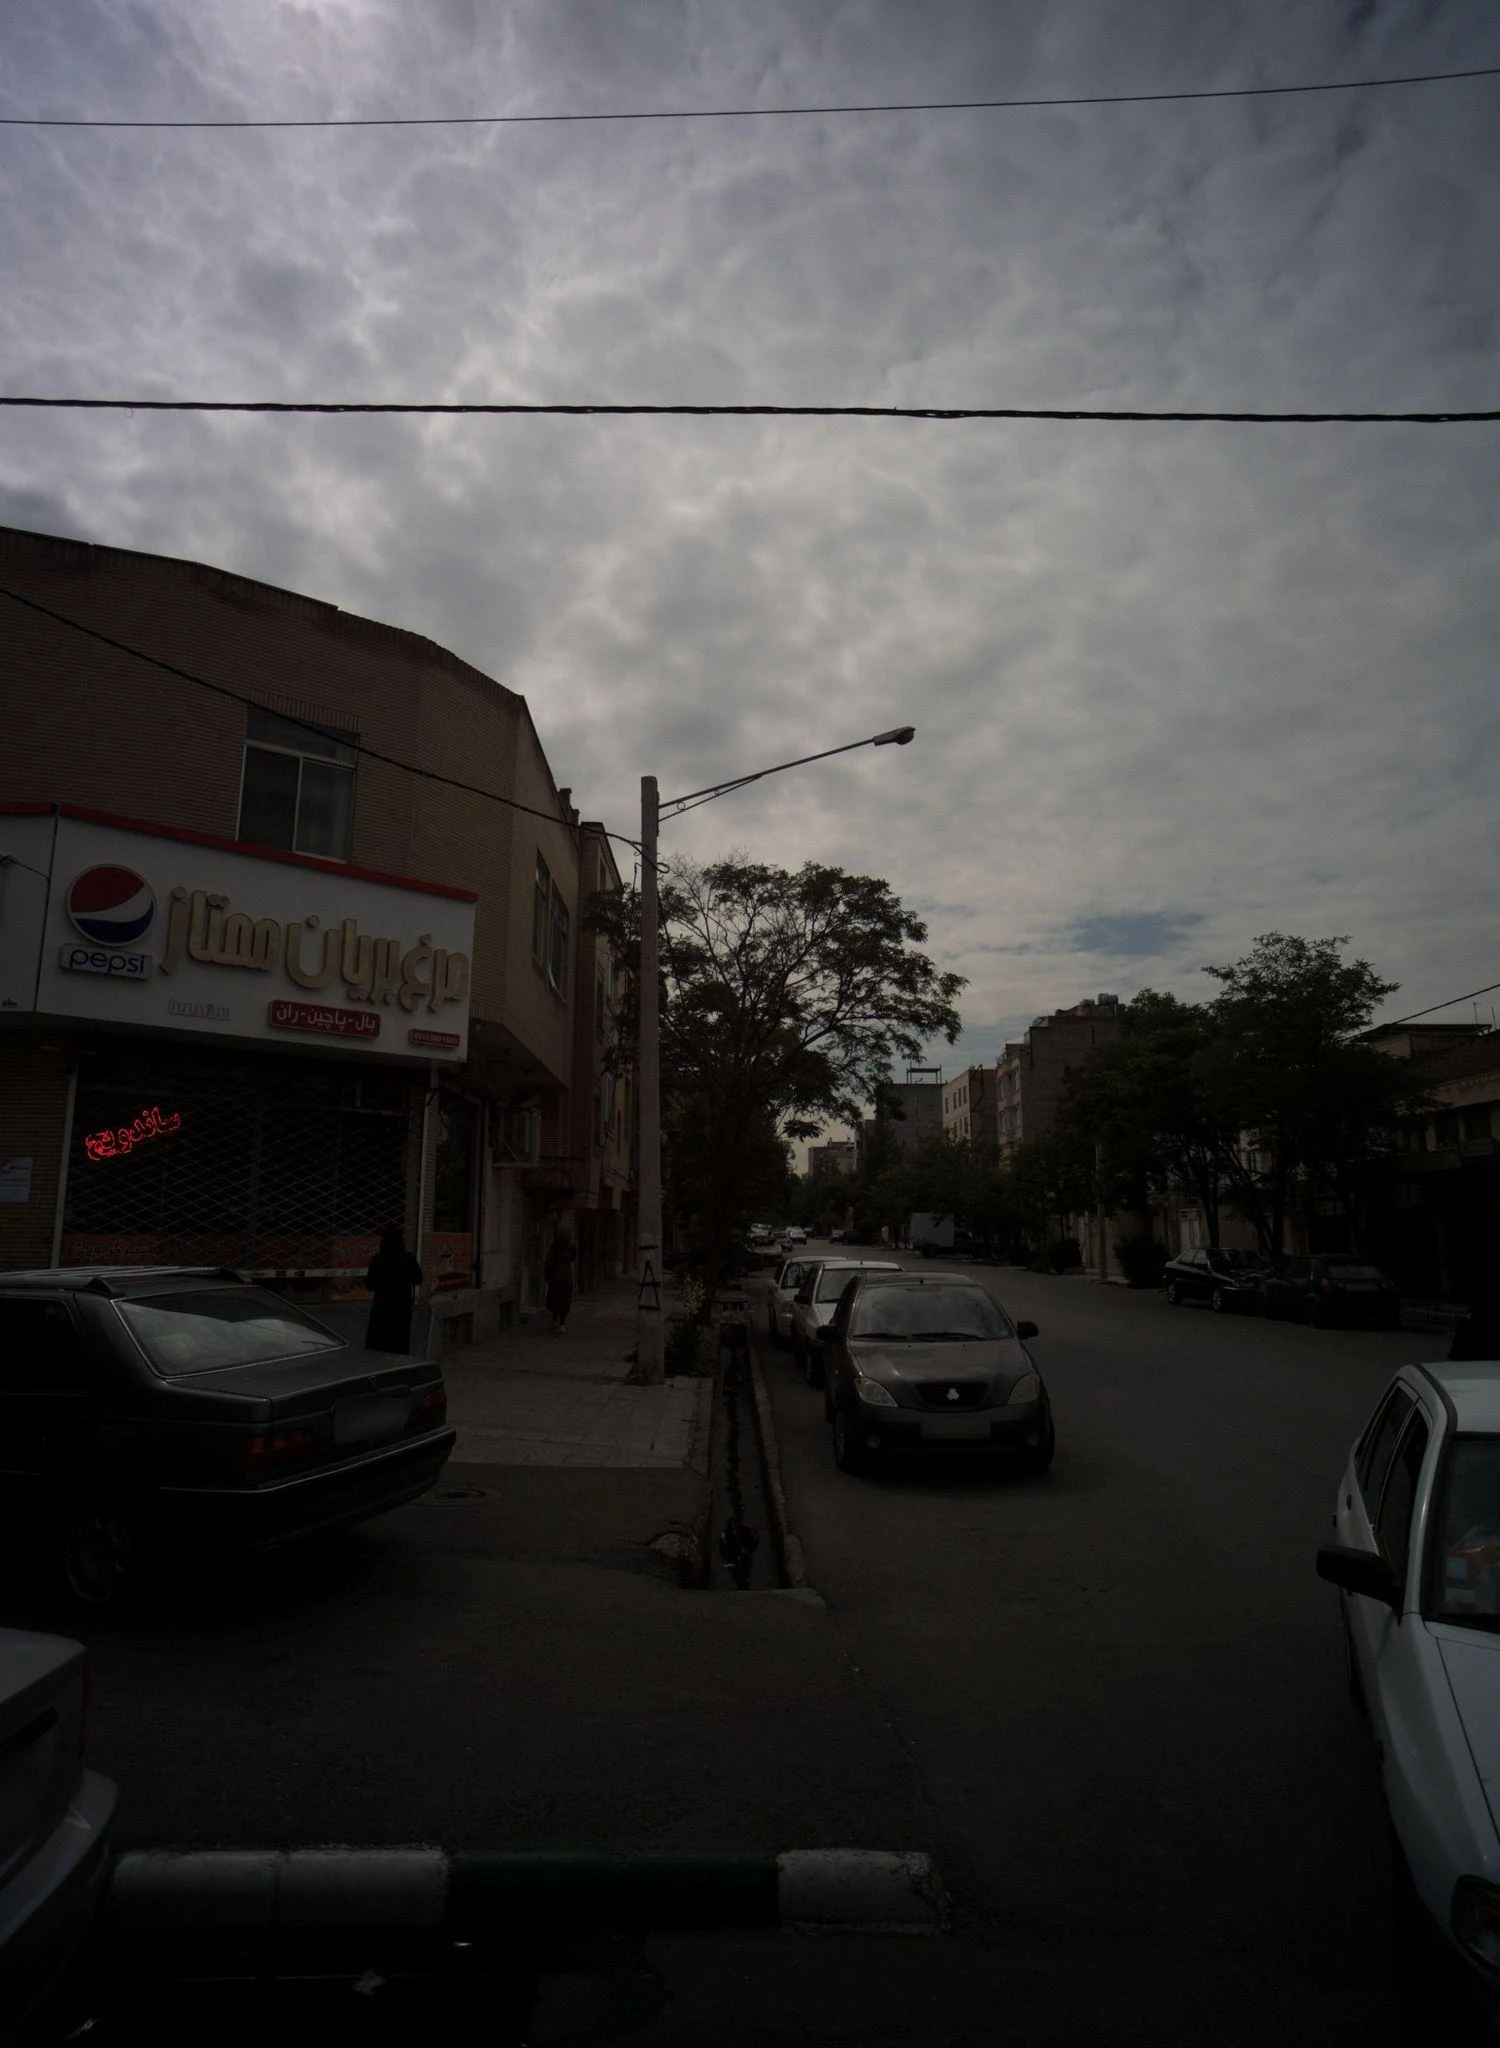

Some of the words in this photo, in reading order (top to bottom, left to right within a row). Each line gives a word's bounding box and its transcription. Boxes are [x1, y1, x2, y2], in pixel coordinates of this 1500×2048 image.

[69, 949, 145, 973] pepsi
[159, 887, 282, 974] ممتاز
[286, 915, 400, 1004] بریان
[399, 934, 470, 1013] مرغ
